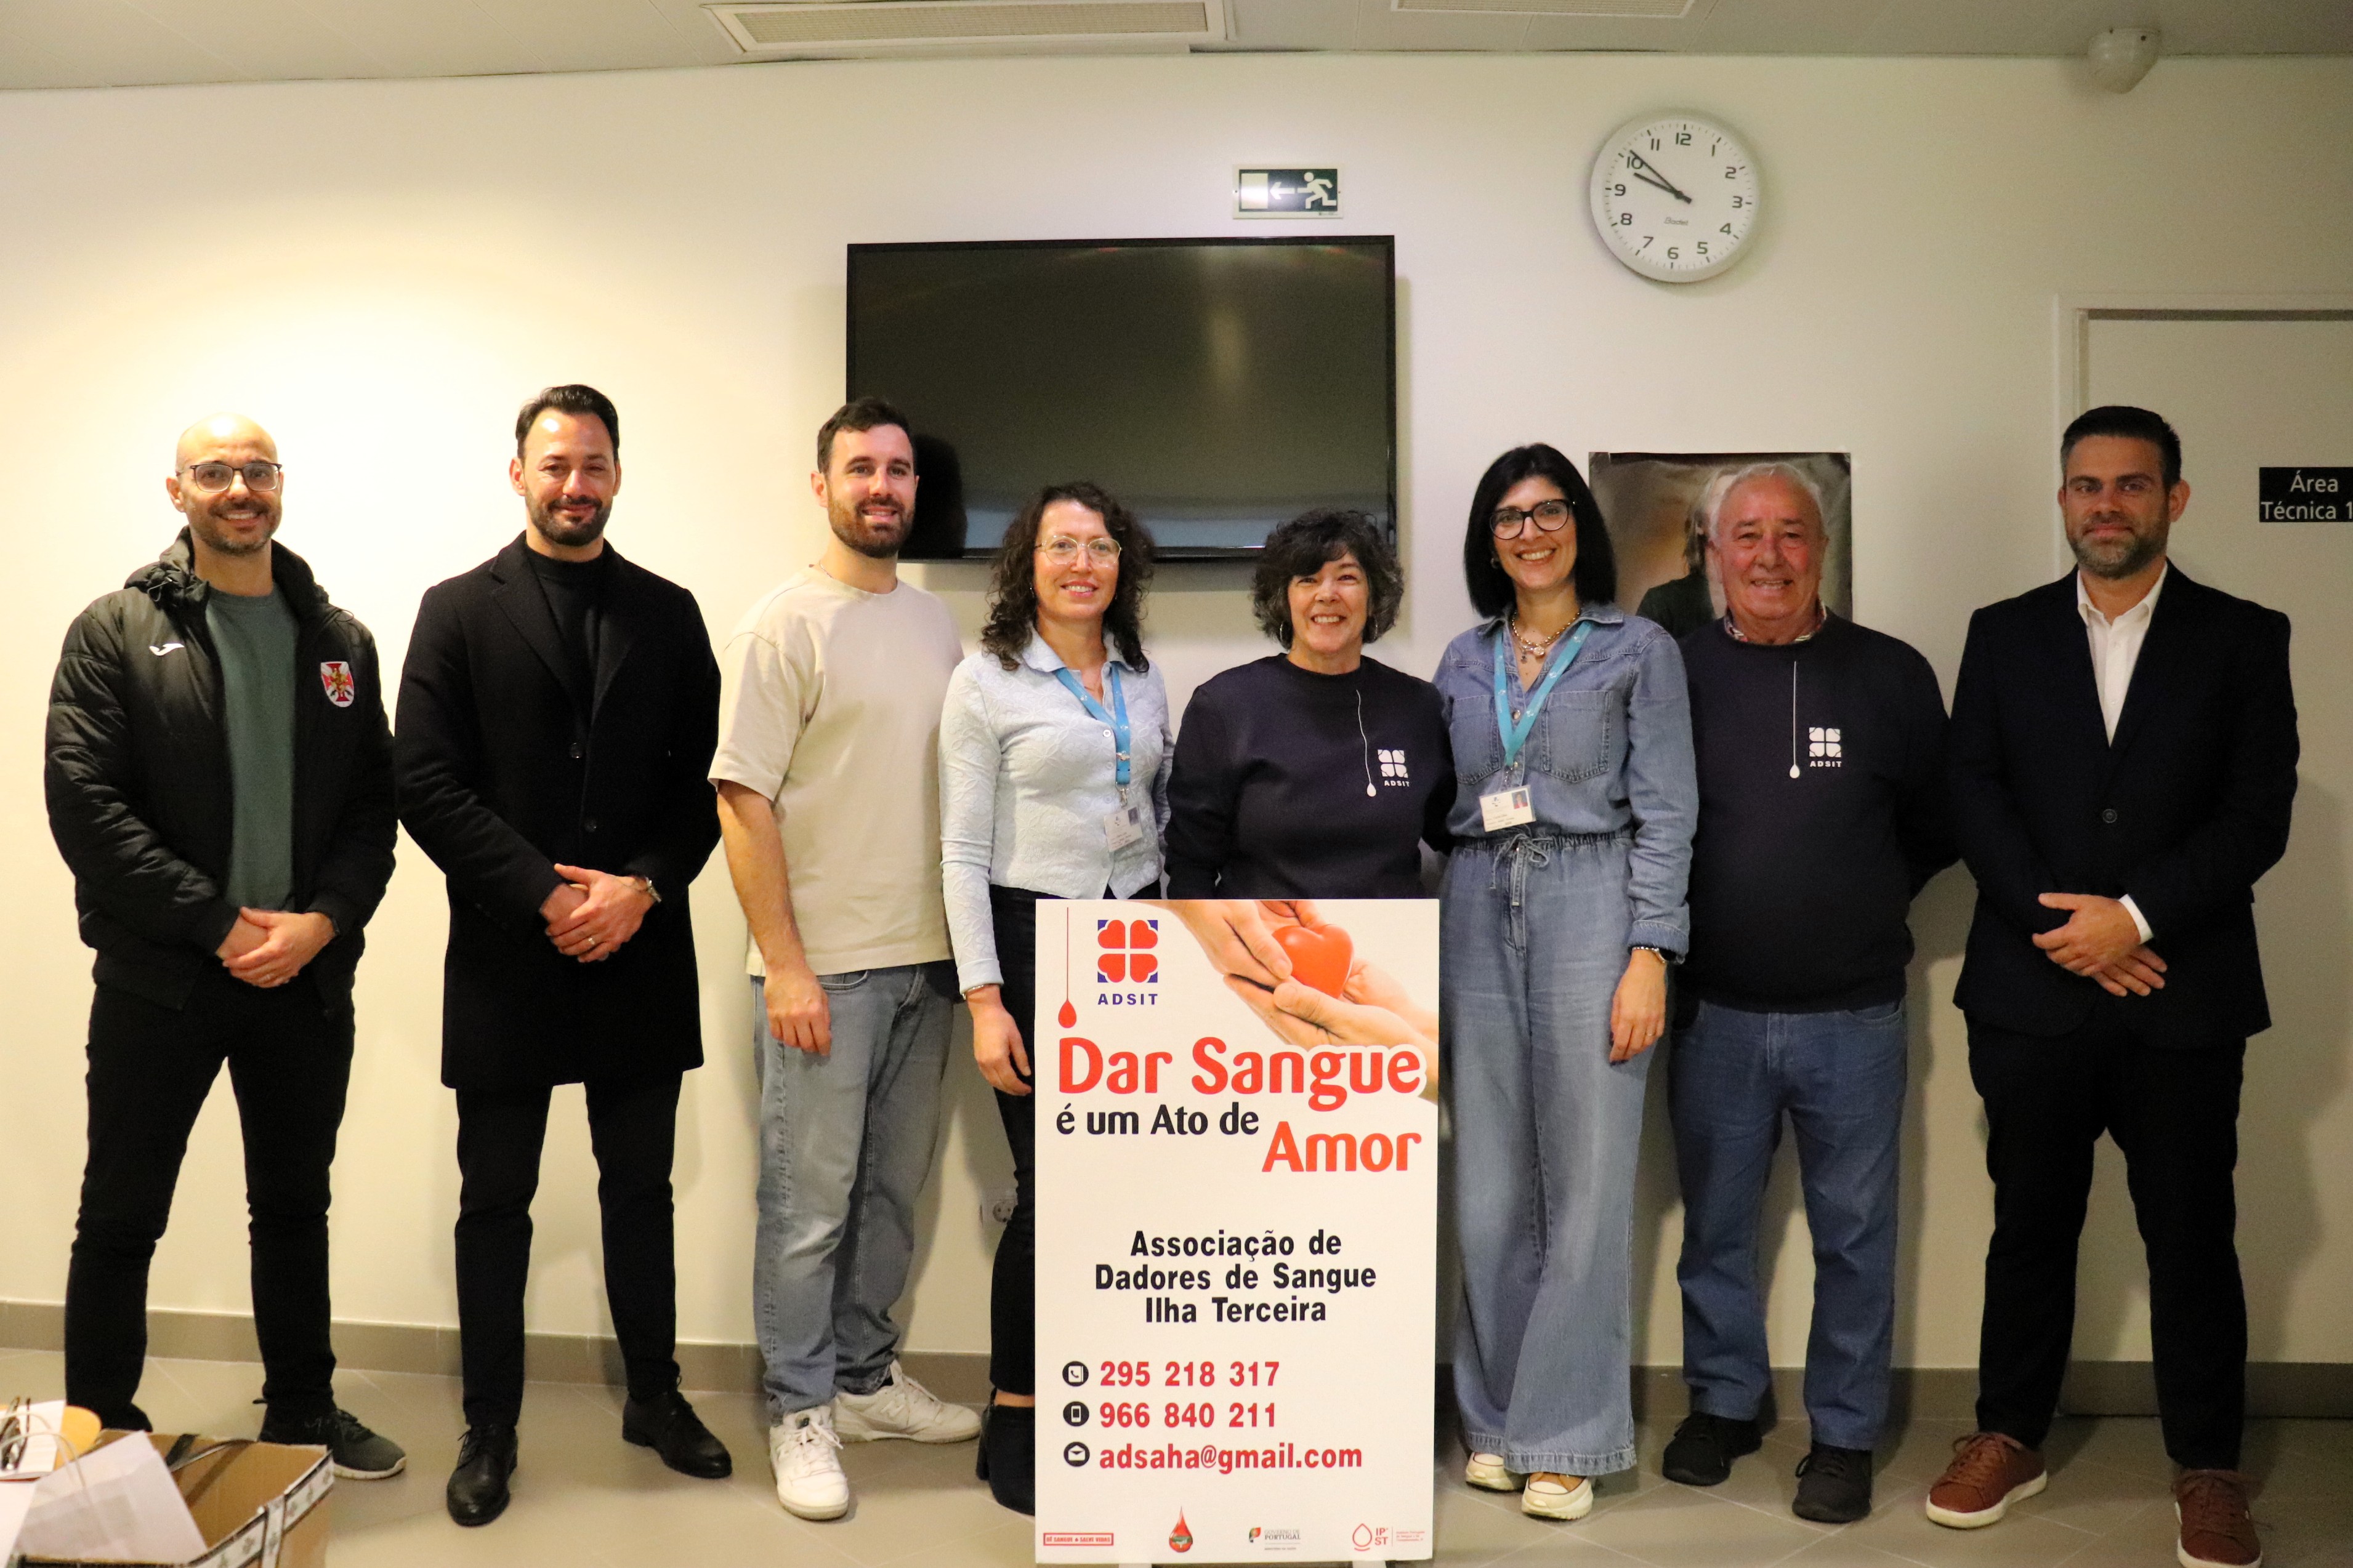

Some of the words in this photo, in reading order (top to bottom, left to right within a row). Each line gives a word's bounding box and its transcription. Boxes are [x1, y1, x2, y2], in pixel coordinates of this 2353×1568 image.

[1650, 138, 1660, 151] 11
[1676, 132, 1692, 146] 12
[1711, 144, 1716, 156] 1
[1626, 156, 1644, 169] 10
[1725, 167, 1737, 179] 2
[1614, 184, 1626, 196] 9
[1732, 196, 1743, 208] 3
[1620, 213, 1633, 225] 8
[1719, 223, 1732, 235] 4
[1642, 236, 1654, 249] 7
[1697, 242, 1708, 254] 5
[1667, 247, 1679, 259] 6
[2290, 470, 2339, 493] Área
[2261, 501, 2337, 520] Técnica
[2346, 501, 2353, 520] 1
[1384, 779, 1410, 787] ADSIT
[1097, 993, 1158, 1005] ADSIT
[1059, 1037, 1173, 1095] Dar
[1191, 1036, 1421, 1112] Sangue
[1056, 1103, 1075, 1135] é
[1086, 1111, 1139, 1135] um
[1150, 1104, 1208, 1136] Ato
[1219, 1101, 1259, 1135] de
[1262, 1120, 1422, 1173] Amor
[1130, 1229, 1294, 1263] Associação
[1309, 1228, 1342, 1255] de
[1096, 1263, 1211, 1290] Dadores
[1225, 1263, 1259, 1290] de
[1273, 1261, 1376, 1294] Sangue
[1145, 1297, 1197, 1324] Ilha
[1211, 1295, 1326, 1323] Terceira
[1100, 1361, 1150, 1387] 295
[1164, 1361, 1215, 1388] 218
[1229, 1361, 1280, 1387] 317
[1099, 1402, 1150, 1428] 966
[1164, 1402, 1215, 1428] 840
[1229, 1402, 1275, 1428] 211
[1099, 1442, 1362, 1475] adsaha@gmail.com
[1374, 1537, 1388, 1546] ST
